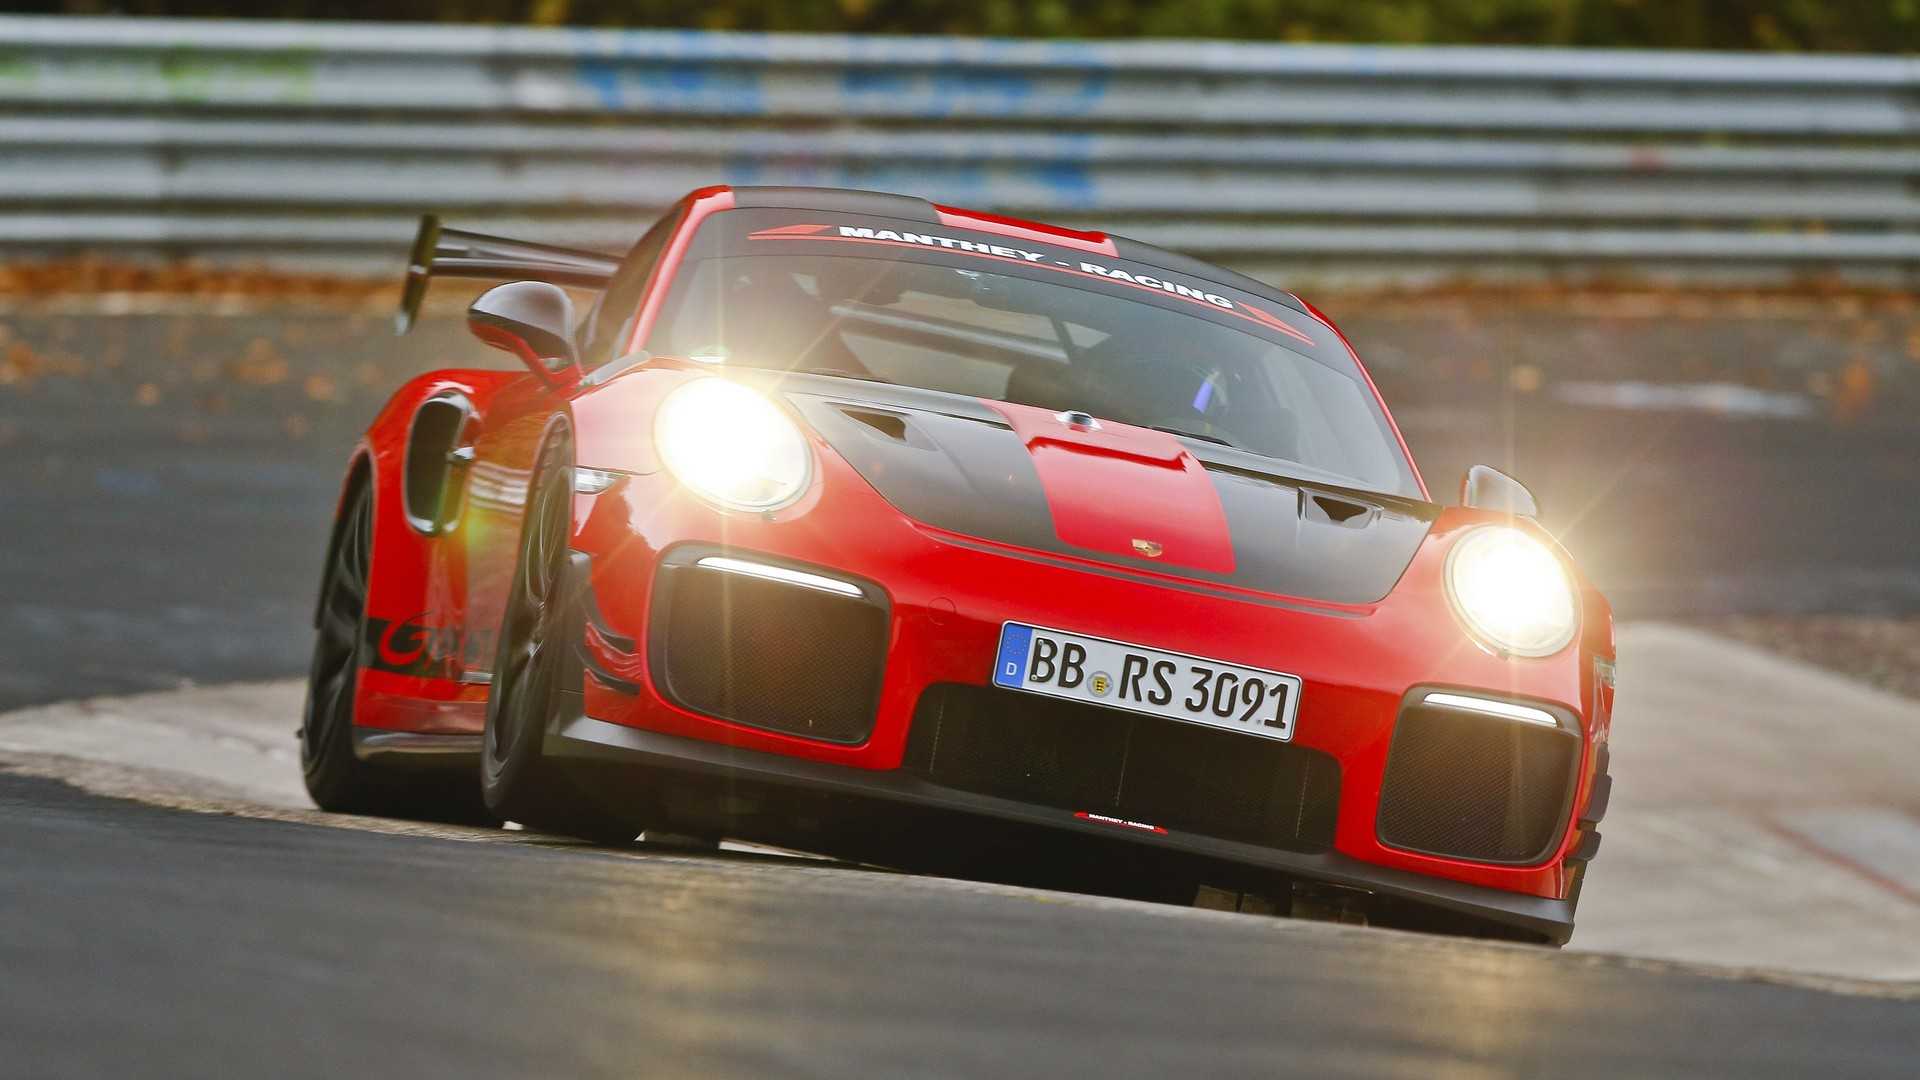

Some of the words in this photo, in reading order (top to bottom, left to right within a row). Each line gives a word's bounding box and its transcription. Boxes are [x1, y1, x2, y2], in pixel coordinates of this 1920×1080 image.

[839, 226, 1043, 261] MANTHEY
[1080, 262, 1233, 308] RACING
[1004, 662, 1018, 676] D
[1029, 637, 1088, 689] BB
[1118, 654, 1177, 706] RS
[1184, 666, 1289, 729] 3091
